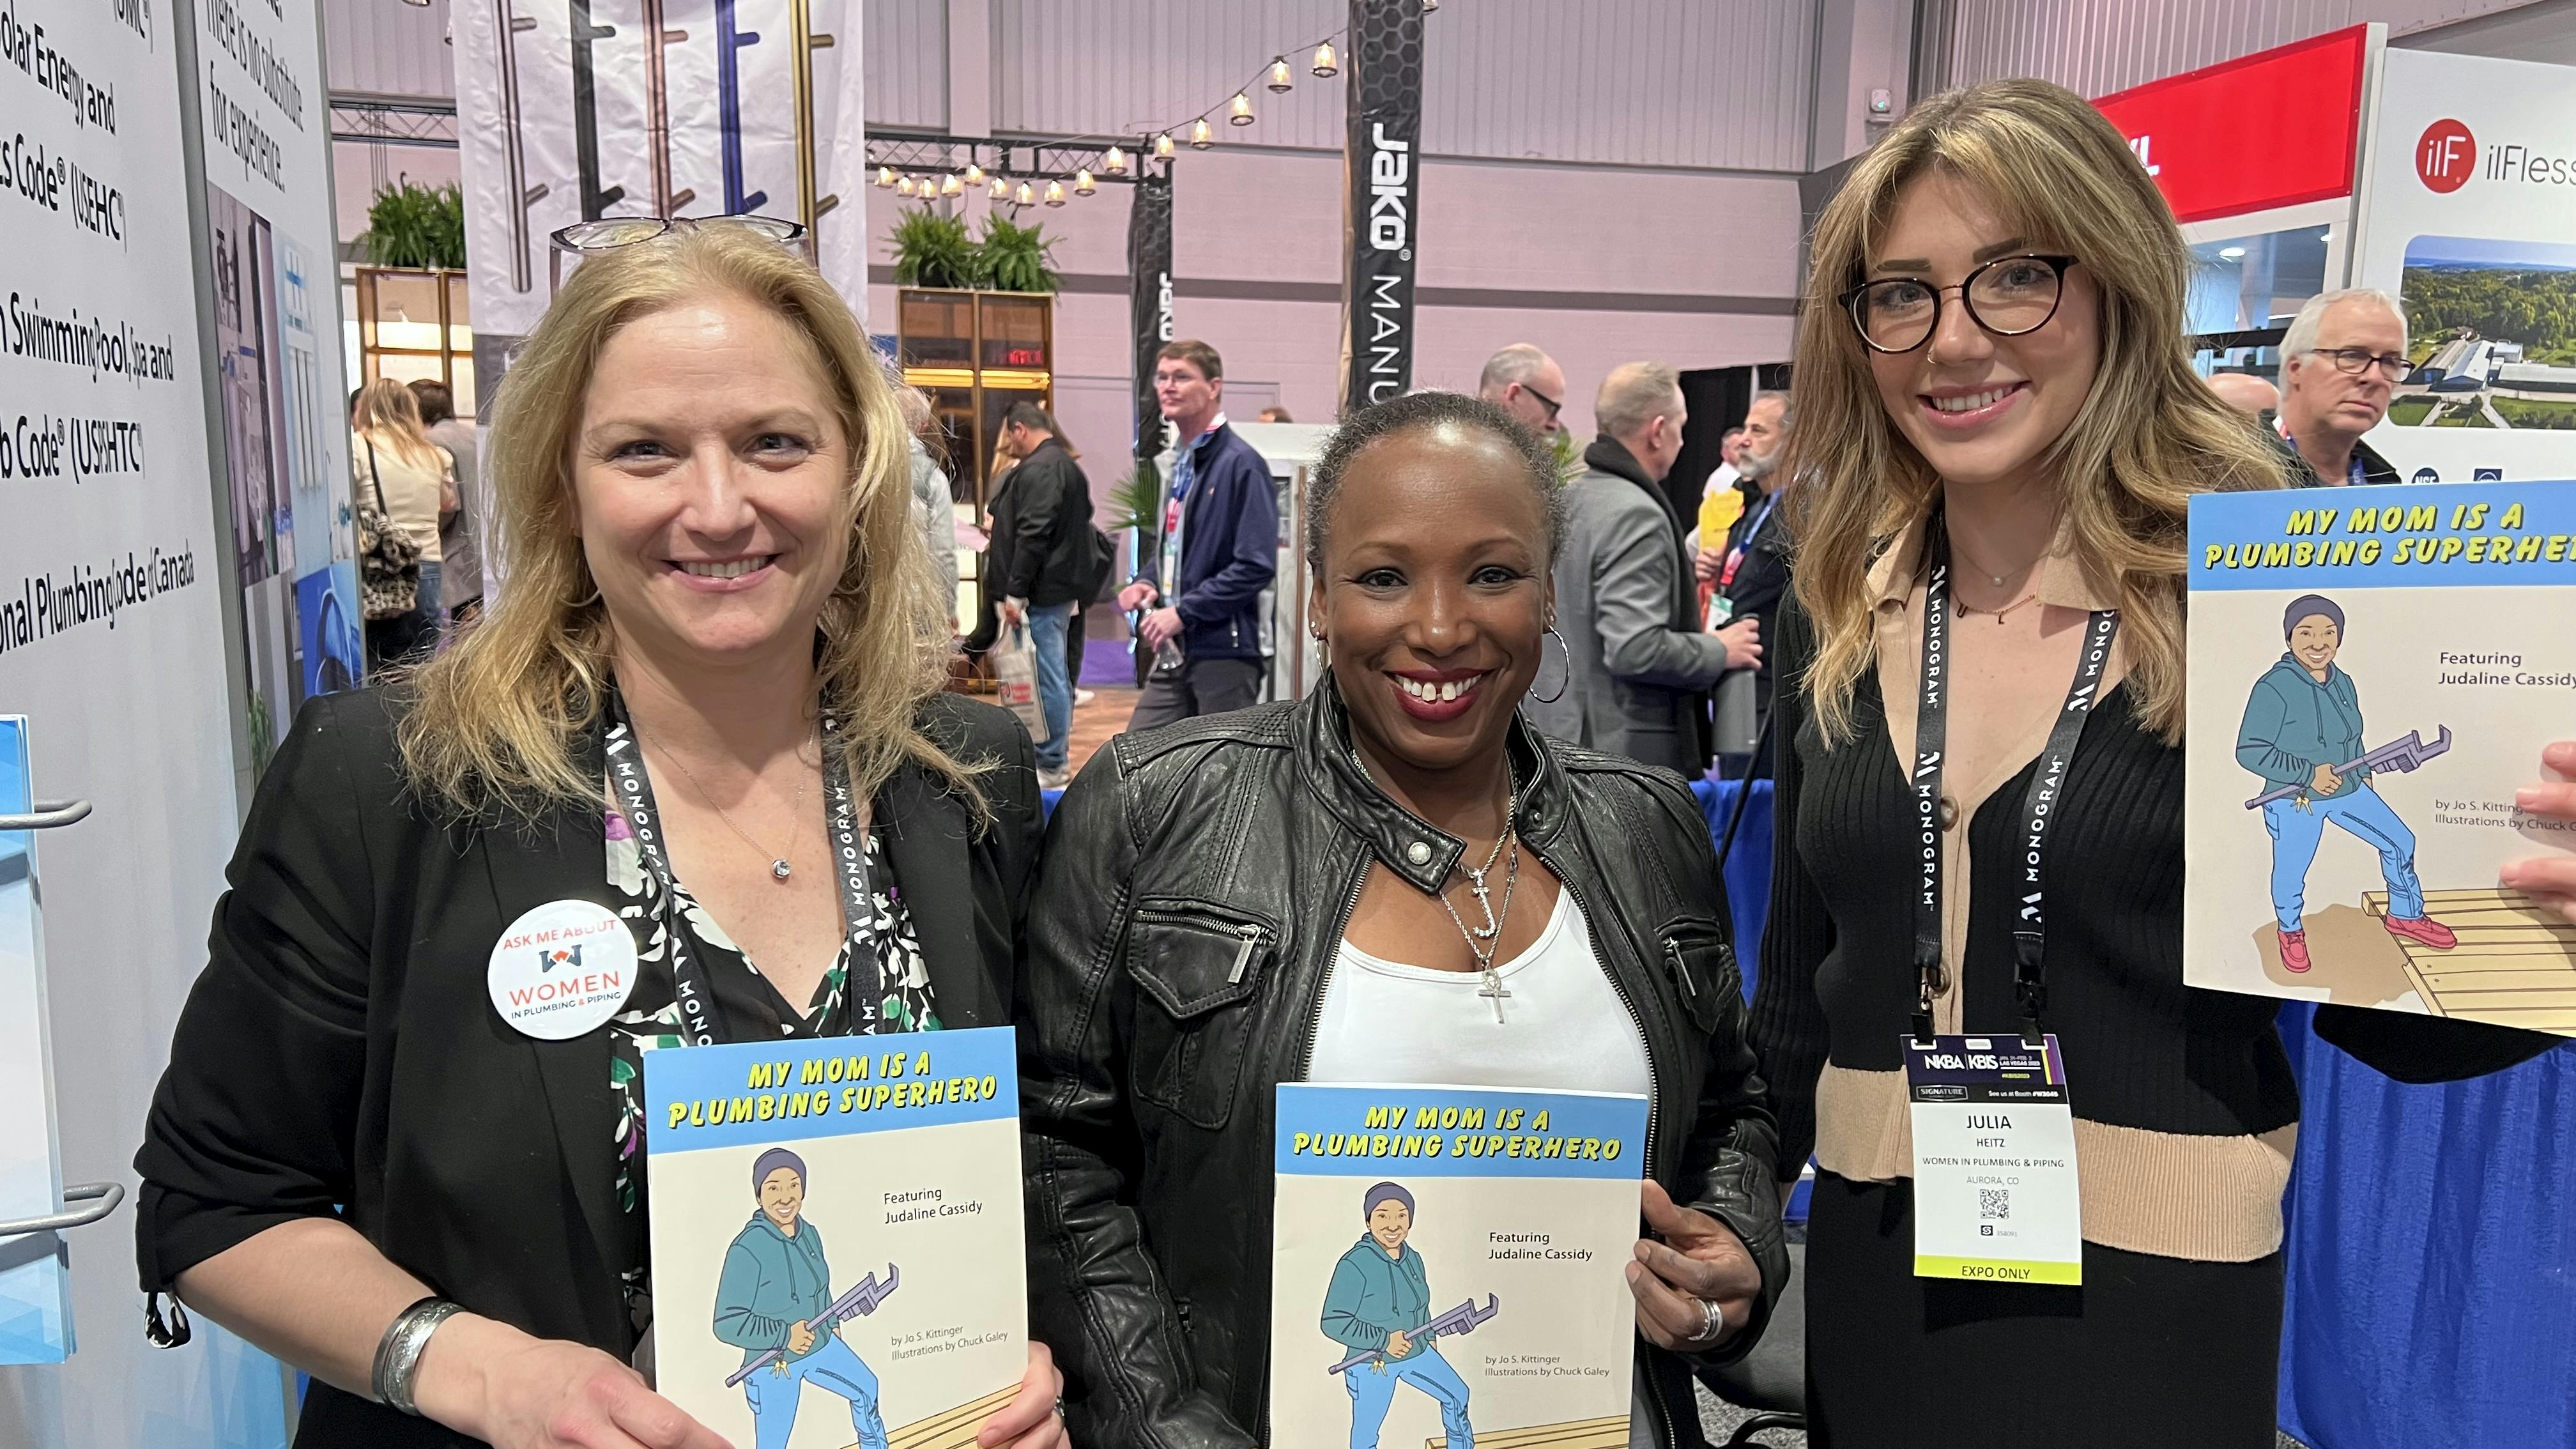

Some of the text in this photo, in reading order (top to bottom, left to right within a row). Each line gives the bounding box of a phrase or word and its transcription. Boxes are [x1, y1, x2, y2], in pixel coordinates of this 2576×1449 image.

[247, 29, 261, 86] no
[34, 23, 84, 130] Energy
[87, 82, 116, 136] and
[210, 60, 228, 147] for
[10, 291, 96, 383] Swimming
[94, 317, 131, 382] Pool,
[130, 326, 148, 390] Spa
[150, 334, 174, 381] and
[2285, 502, 2525, 535] MY MOM IS A
[2204, 539, 2381, 570] PLUMBING
[36, 564, 114, 639] Plumbing
[111, 552, 147, 607] Code
[153, 538, 194, 592] Canada
[2440, 652, 2522, 668] Featuring
[2439, 671, 2510, 685] Judaline
[2435, 799, 2450, 811] by
[2453, 801, 2466, 810] Jo
[2469, 801, 2480, 811] S.
[2435, 814, 2505, 827] Illustrations
[2510, 818, 2524, 831] by
[2527, 819, 2566, 831] Chuck
[503, 919, 617, 950] ASK ME ABOUT
[509, 971, 619, 1006] WOMEN
[524, 1000, 576, 1018] PLUMBING
[587, 992, 621, 1004] PIPING
[747, 1050, 931, 1089] MY MOM IS A
[1924, 1054, 1965, 1070] NKBA
[1968, 1054, 1998, 1070] KBIS
[668, 1074, 998, 1130] PLUMBING SUPERHERO
[1364, 1106, 1550, 1131] MY MOM IS A
[1966, 1115, 2012, 1129] JULIA
[1292, 1131, 1622, 1162] PLUMBING SUPERHERO
[1977, 1138, 2005, 1147] HEITZ
[1922, 1157, 1958, 1165] WOMEN
[1961, 1158, 1970, 1166] IN
[1974, 1158, 2021, 1167] PLUMBING
[1966, 1176, 2019, 1186] AURORA, CO
[884, 1188, 942, 1205] Featuring
[885, 1200, 983, 1224] Judaline Cassidy
[1489, 1232, 1549, 1245] Featuring
[1489, 1248, 1593, 1262] Judaline Cassidy
[1961, 1266, 2030, 1280] EXPO ONLY
[891, 1326, 963, 1347] by Jo S. Kittinger
[891, 1331, 1008, 1361] Illustrations by Chuck Galey
[1485, 1354, 1560, 1366] by Jo S. Kittinger
[1485, 1367, 1610, 1377] Illustrations by Chuck Galey
